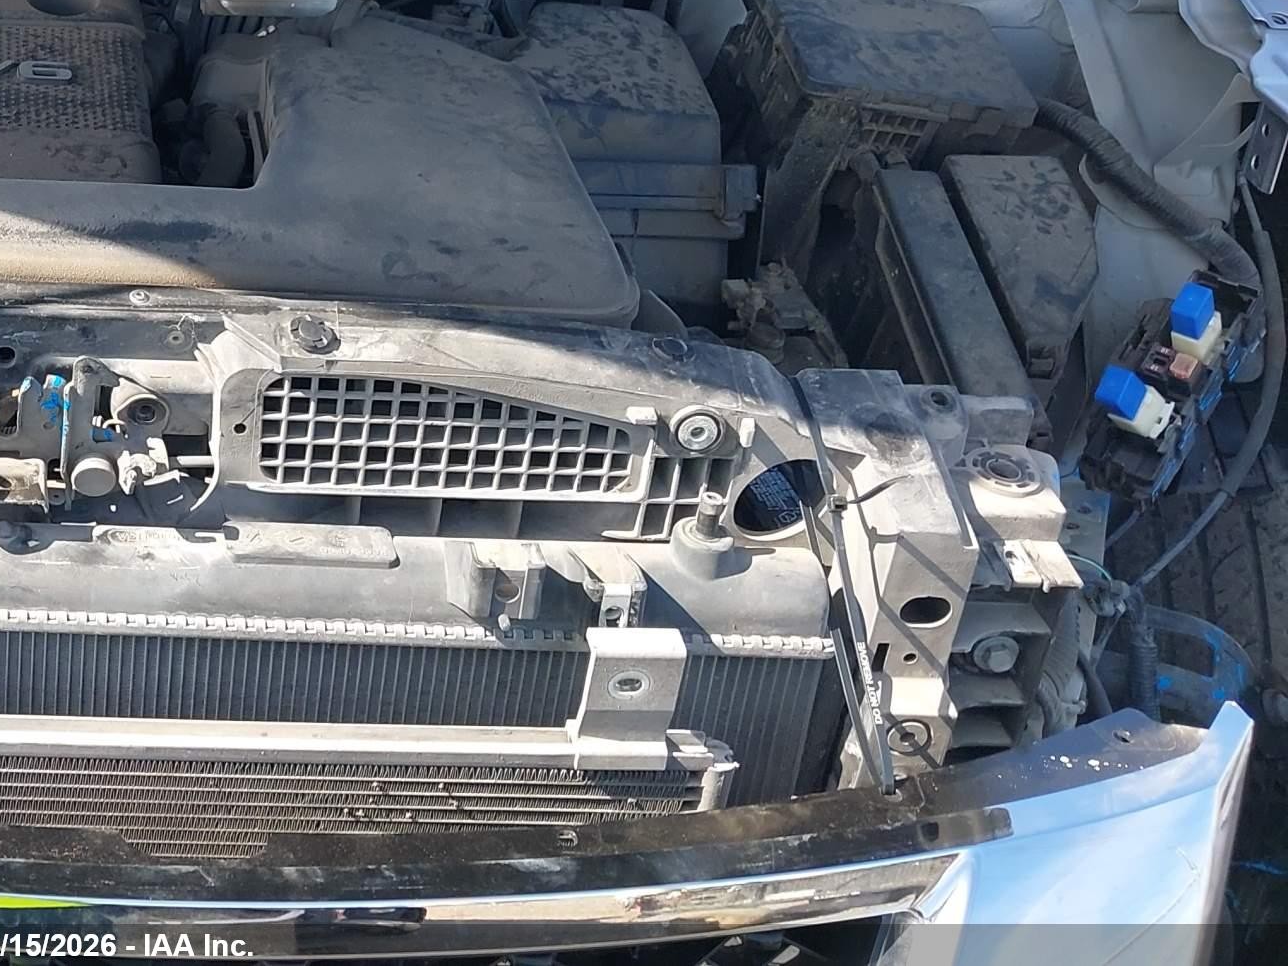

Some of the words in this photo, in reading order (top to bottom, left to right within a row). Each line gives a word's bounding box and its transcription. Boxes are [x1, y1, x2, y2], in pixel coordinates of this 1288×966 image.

[857, 641, 874, 685] REMOVE
[866, 685, 880, 708] NOT
[873, 708, 883, 725] DO
